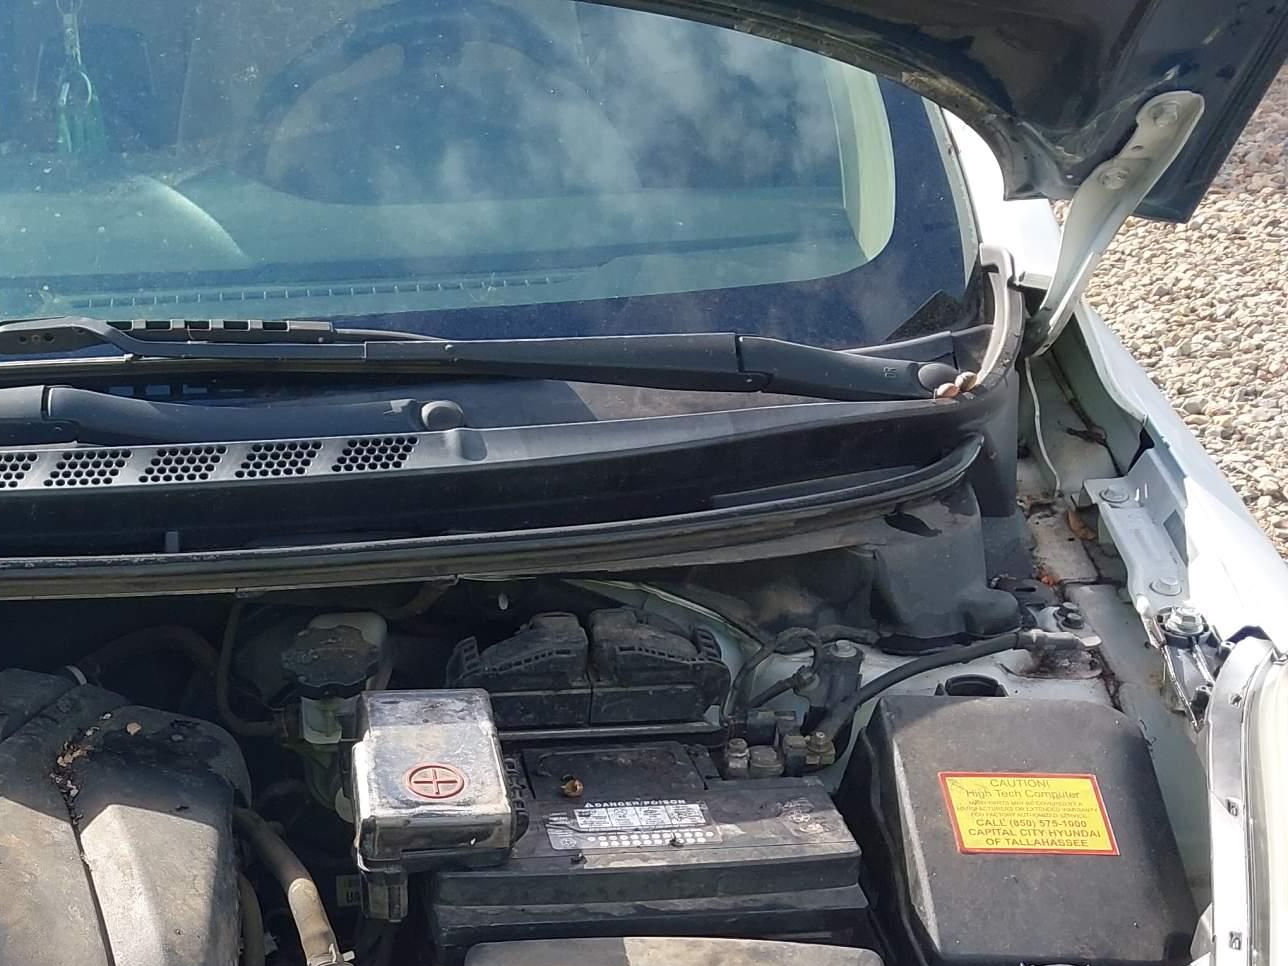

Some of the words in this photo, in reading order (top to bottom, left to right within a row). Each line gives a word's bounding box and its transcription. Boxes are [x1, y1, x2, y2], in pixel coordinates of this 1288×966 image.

[989, 779, 1050, 787] CAUTION!
[965, 789, 992, 799] High
[1024, 789, 1082, 800] Computer
[594, 799, 686, 808] DANGER/POISON
[975, 818, 1008, 827] CALL
[1008, 818, 1036, 827] (850)
[1038, 819, 1088, 829] 575-1000
[967, 827, 1017, 836] CAPITAL
[1019, 829, 1046, 837] CITY
[1048, 829, 1101, 838] HYUNDAI
[984, 837, 1003, 846] OF
[1005, 837, 1089, 847] TALLAHASSEE
